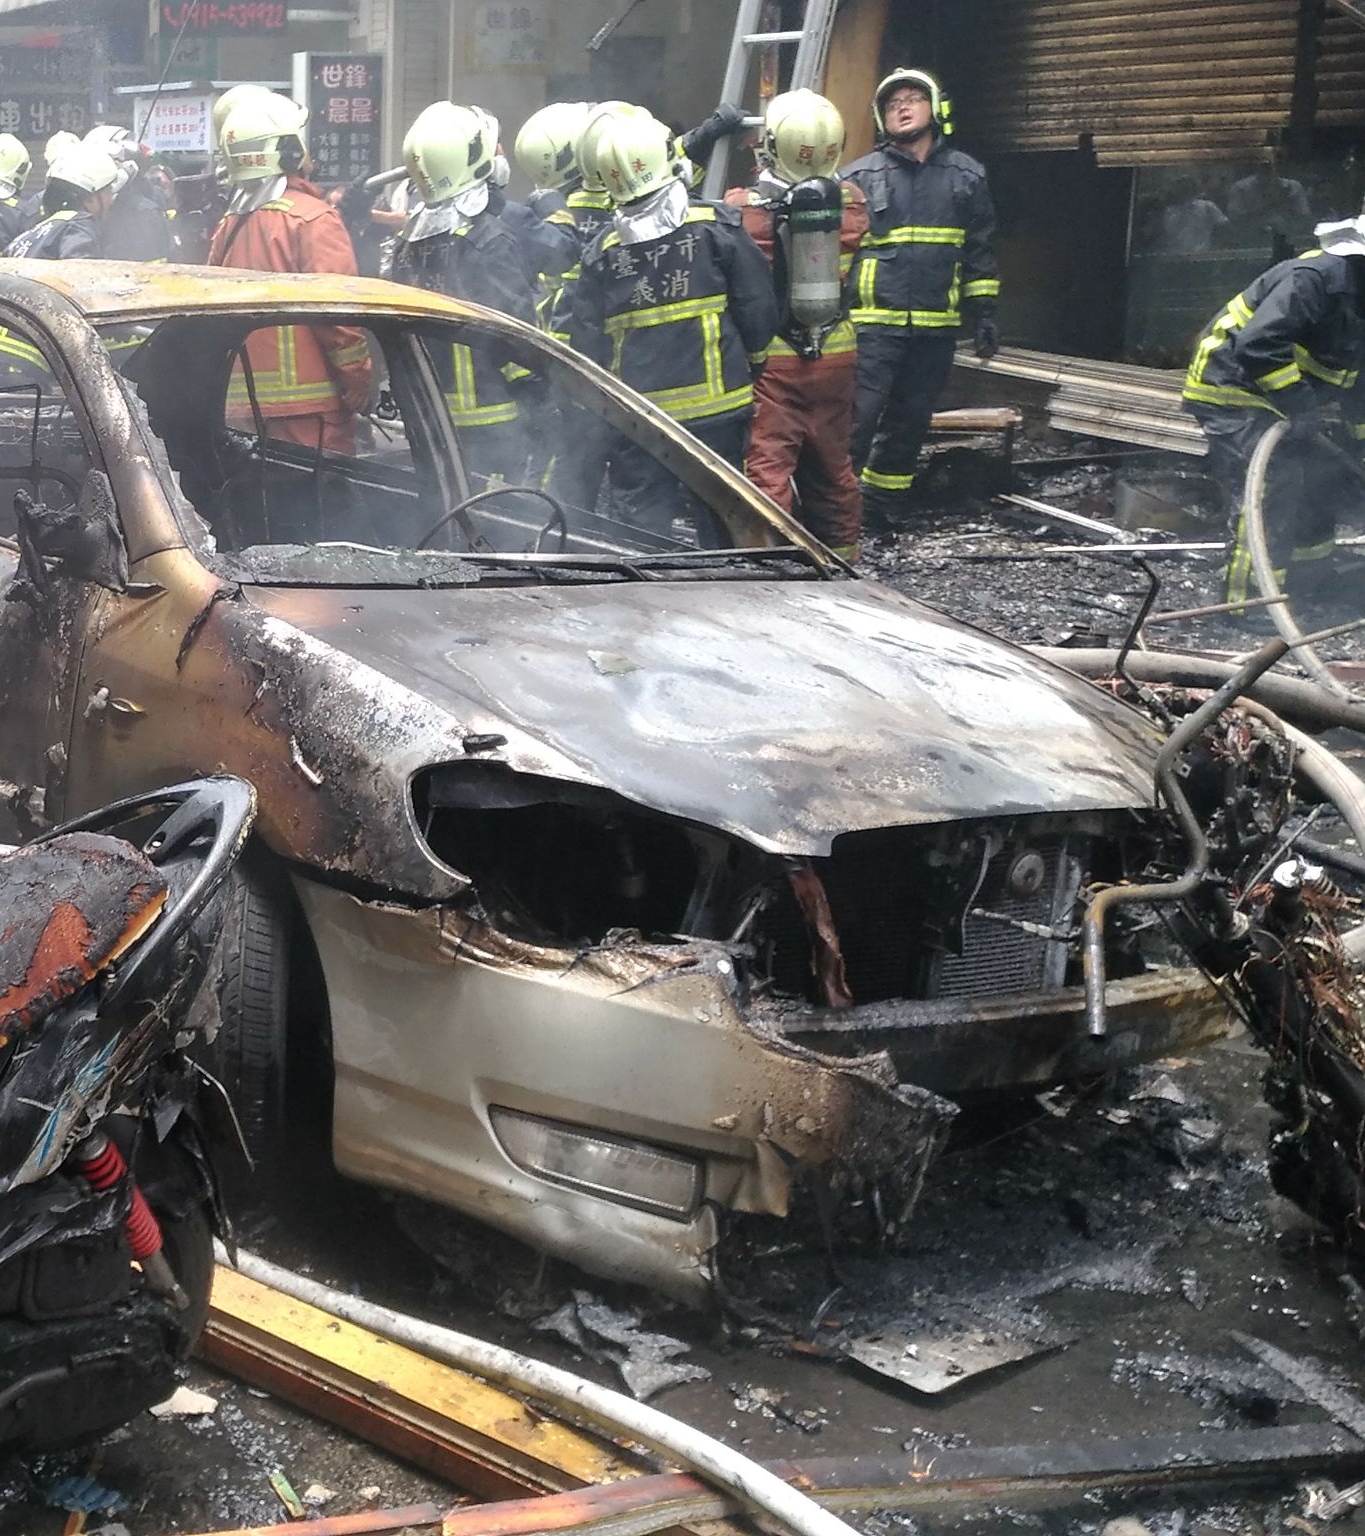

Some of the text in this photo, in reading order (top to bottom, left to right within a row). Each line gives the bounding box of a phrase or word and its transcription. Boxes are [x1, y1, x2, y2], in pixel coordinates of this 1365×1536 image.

[611, 232, 701, 280] 臺中市
[630, 269, 691, 305] 義消
